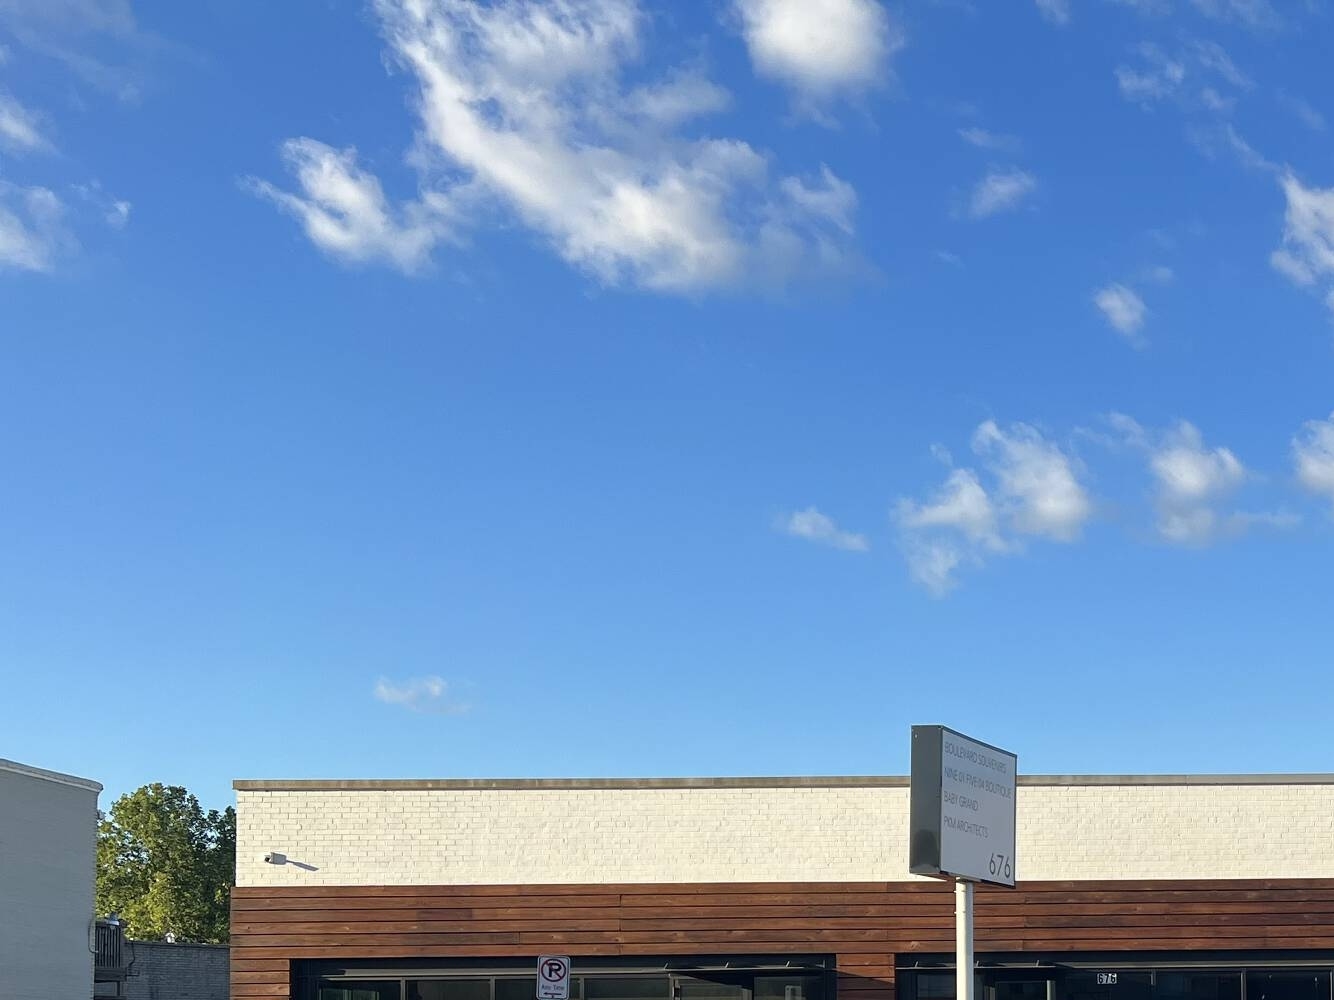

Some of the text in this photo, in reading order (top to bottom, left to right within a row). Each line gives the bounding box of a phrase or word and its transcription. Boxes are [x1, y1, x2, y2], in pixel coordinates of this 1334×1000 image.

[944, 789, 979, 811] BABY GRAND
[957, 819, 989, 839] ARCHITECTS
[989, 852, 1011, 879] 676
[1098, 973, 1116, 984] 676
